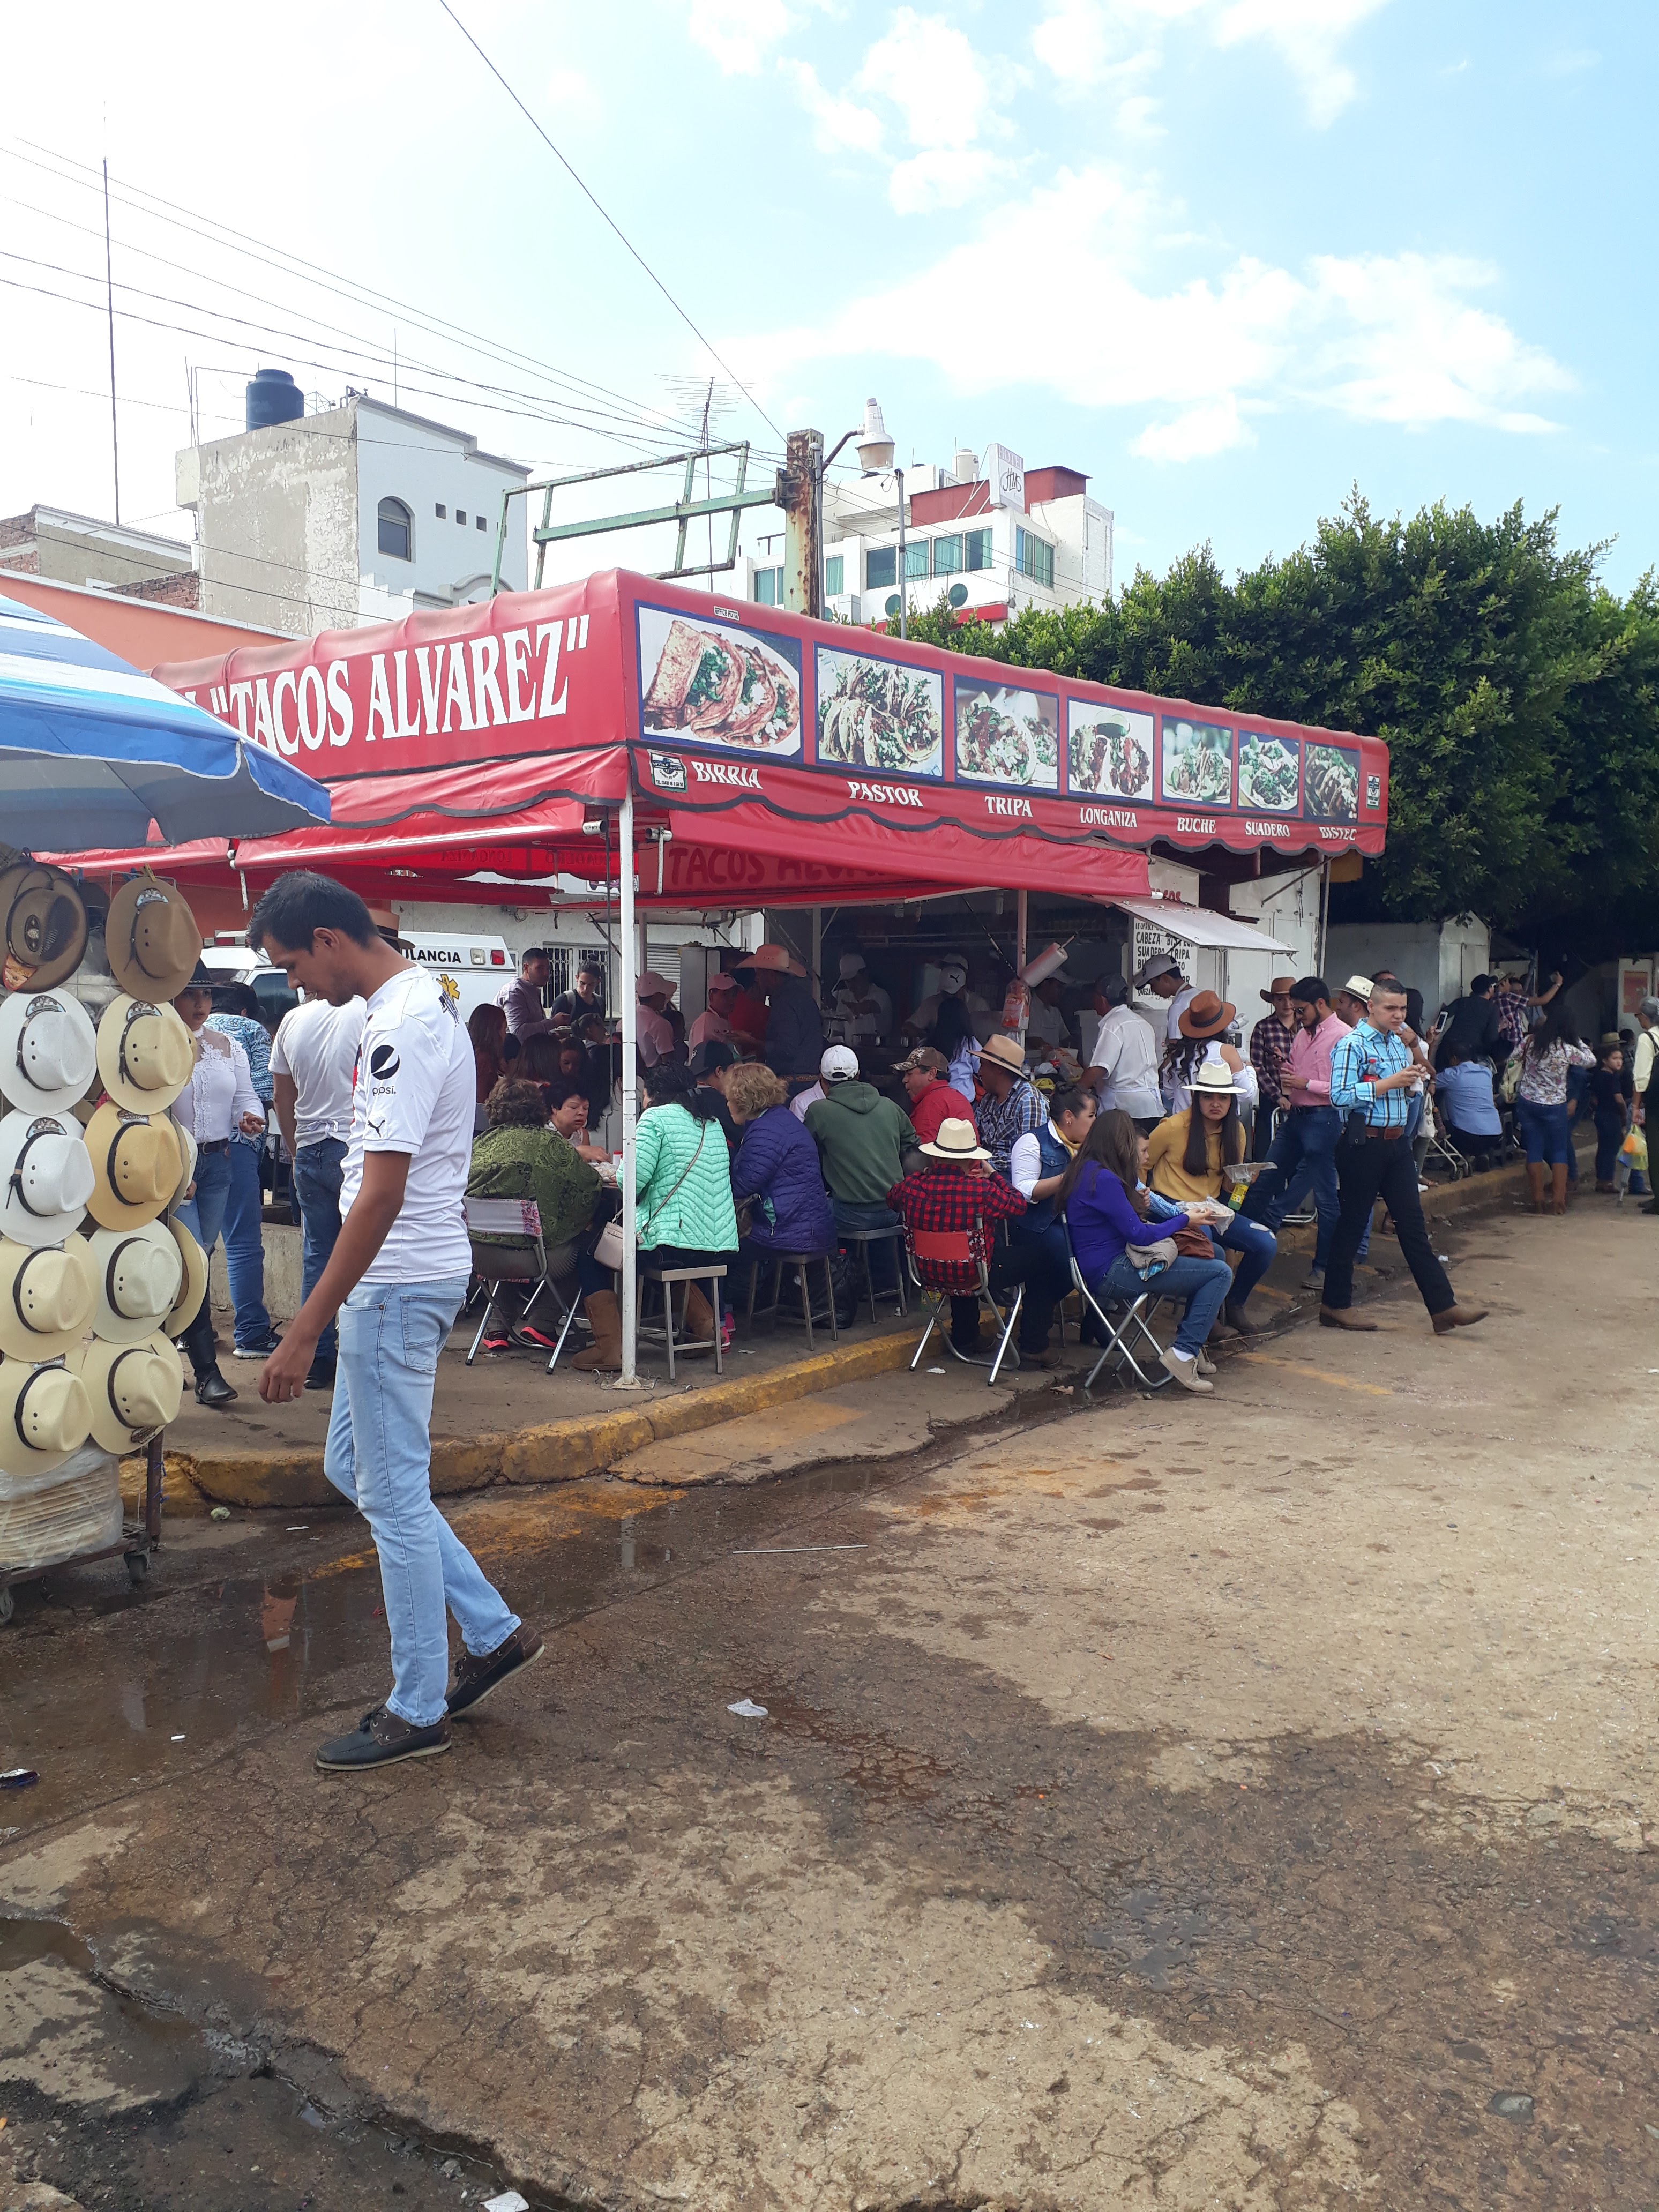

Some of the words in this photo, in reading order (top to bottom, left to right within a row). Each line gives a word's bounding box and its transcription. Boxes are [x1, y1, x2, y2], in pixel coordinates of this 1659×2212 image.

[998, 444, 1023, 470] HOTEL
[210, 660, 354, 757] "TACOS
[365, 614, 590, 742] ALVAREZ"
[691, 761, 763, 789] BIRRIA
[847, 781, 924, 808] PASTOR
[984, 796, 1033, 818] TRIPA
[1080, 807, 1138, 828] LONGANIZA
[1177, 817, 1216, 834] BUCHE
[1245, 821, 1290, 838] SUADERO
[1319, 826, 1357, 841] BISTEC
[668, 847, 766, 886] TACOS
[1135, 931, 1161, 945] CABEZA
[1170, 948, 1190, 960] TRIPA
